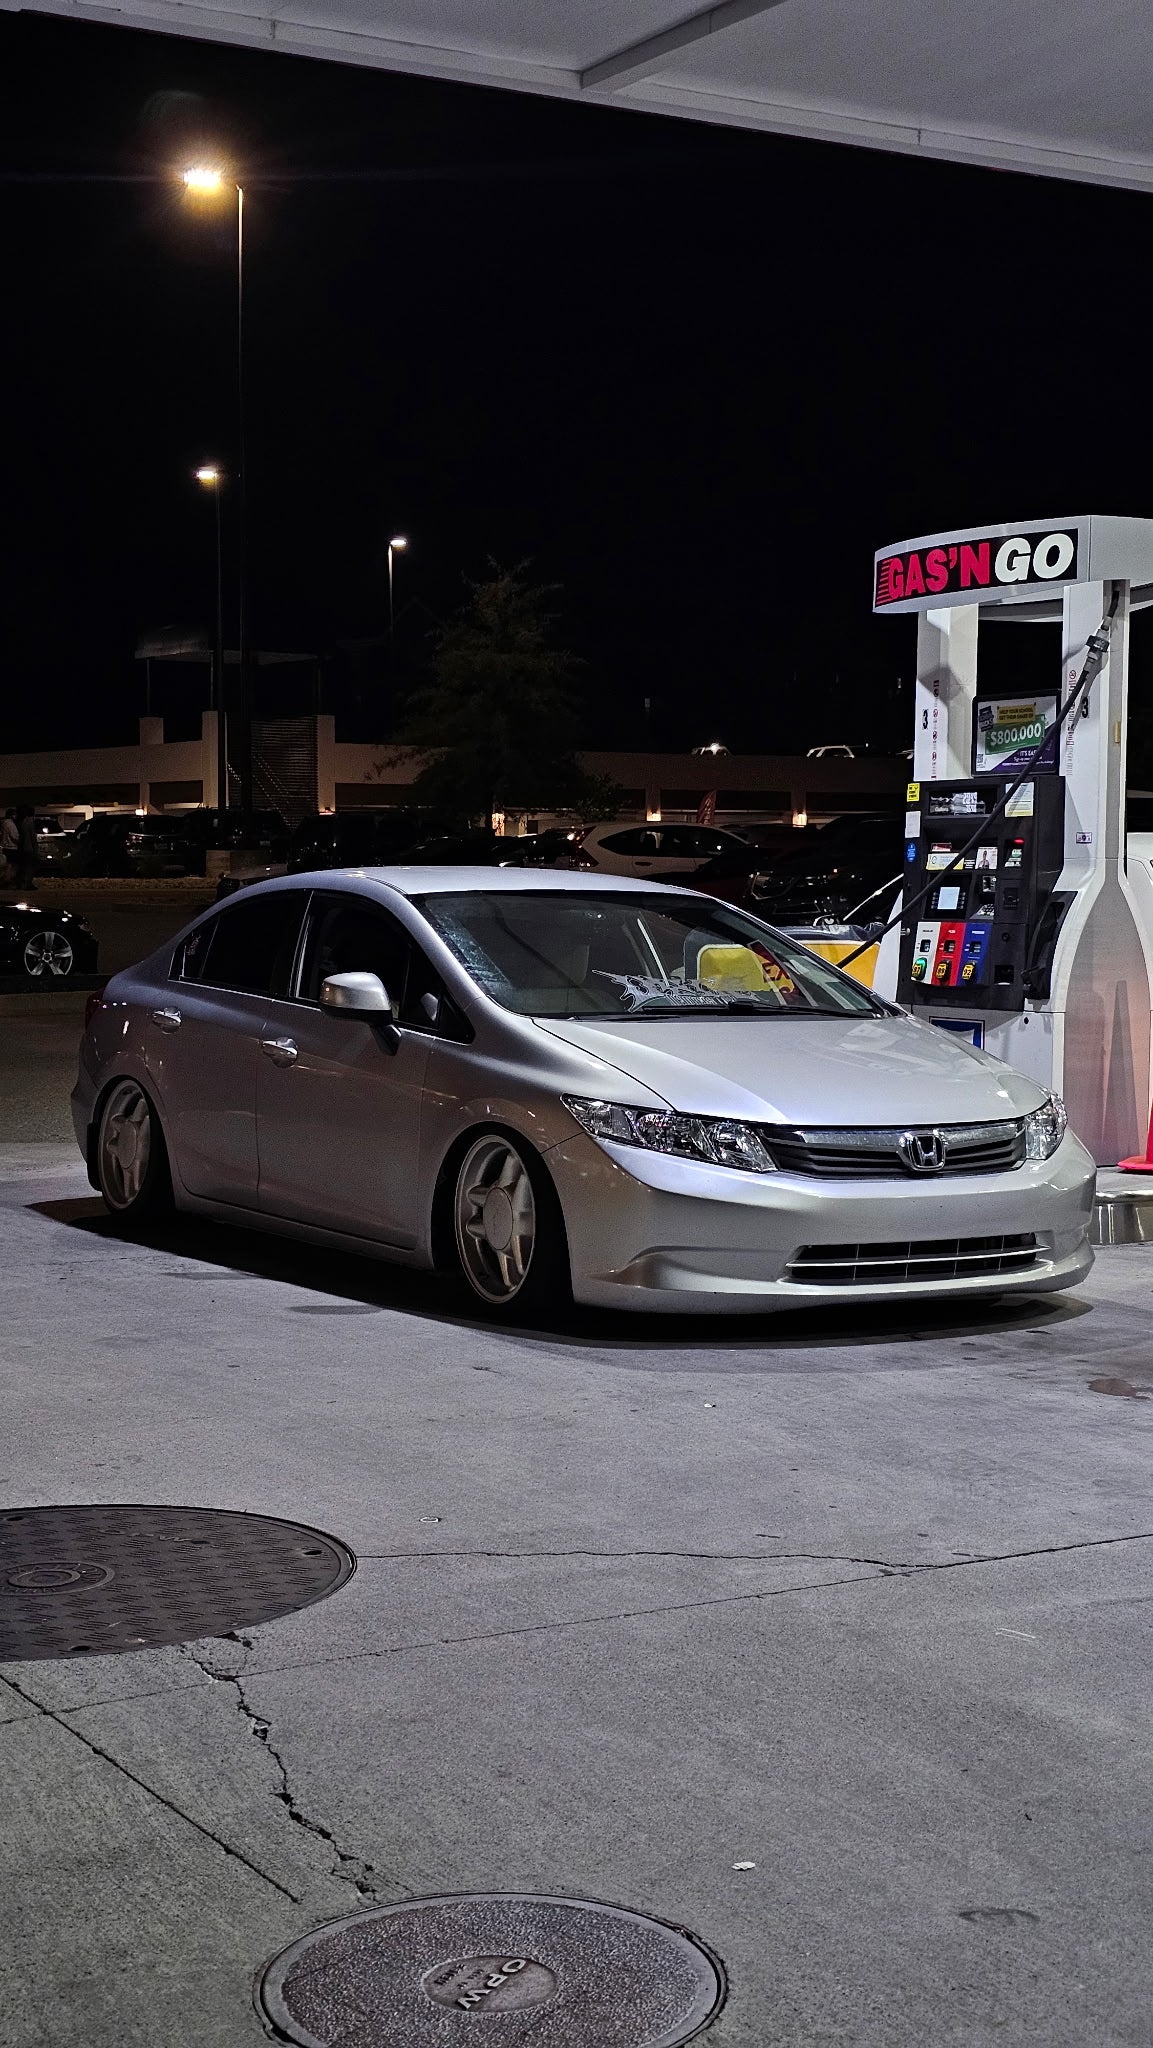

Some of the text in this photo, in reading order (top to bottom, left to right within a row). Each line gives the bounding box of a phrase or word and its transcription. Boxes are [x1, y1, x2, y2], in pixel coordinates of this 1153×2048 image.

[886, 533, 1074, 601] GAS'N GO
[922, 709, 929, 730] 3
[1081, 696, 1089, 718] 3
[990, 722, 1042, 747] $800,000
[456, 1958, 527, 2010] OPW
